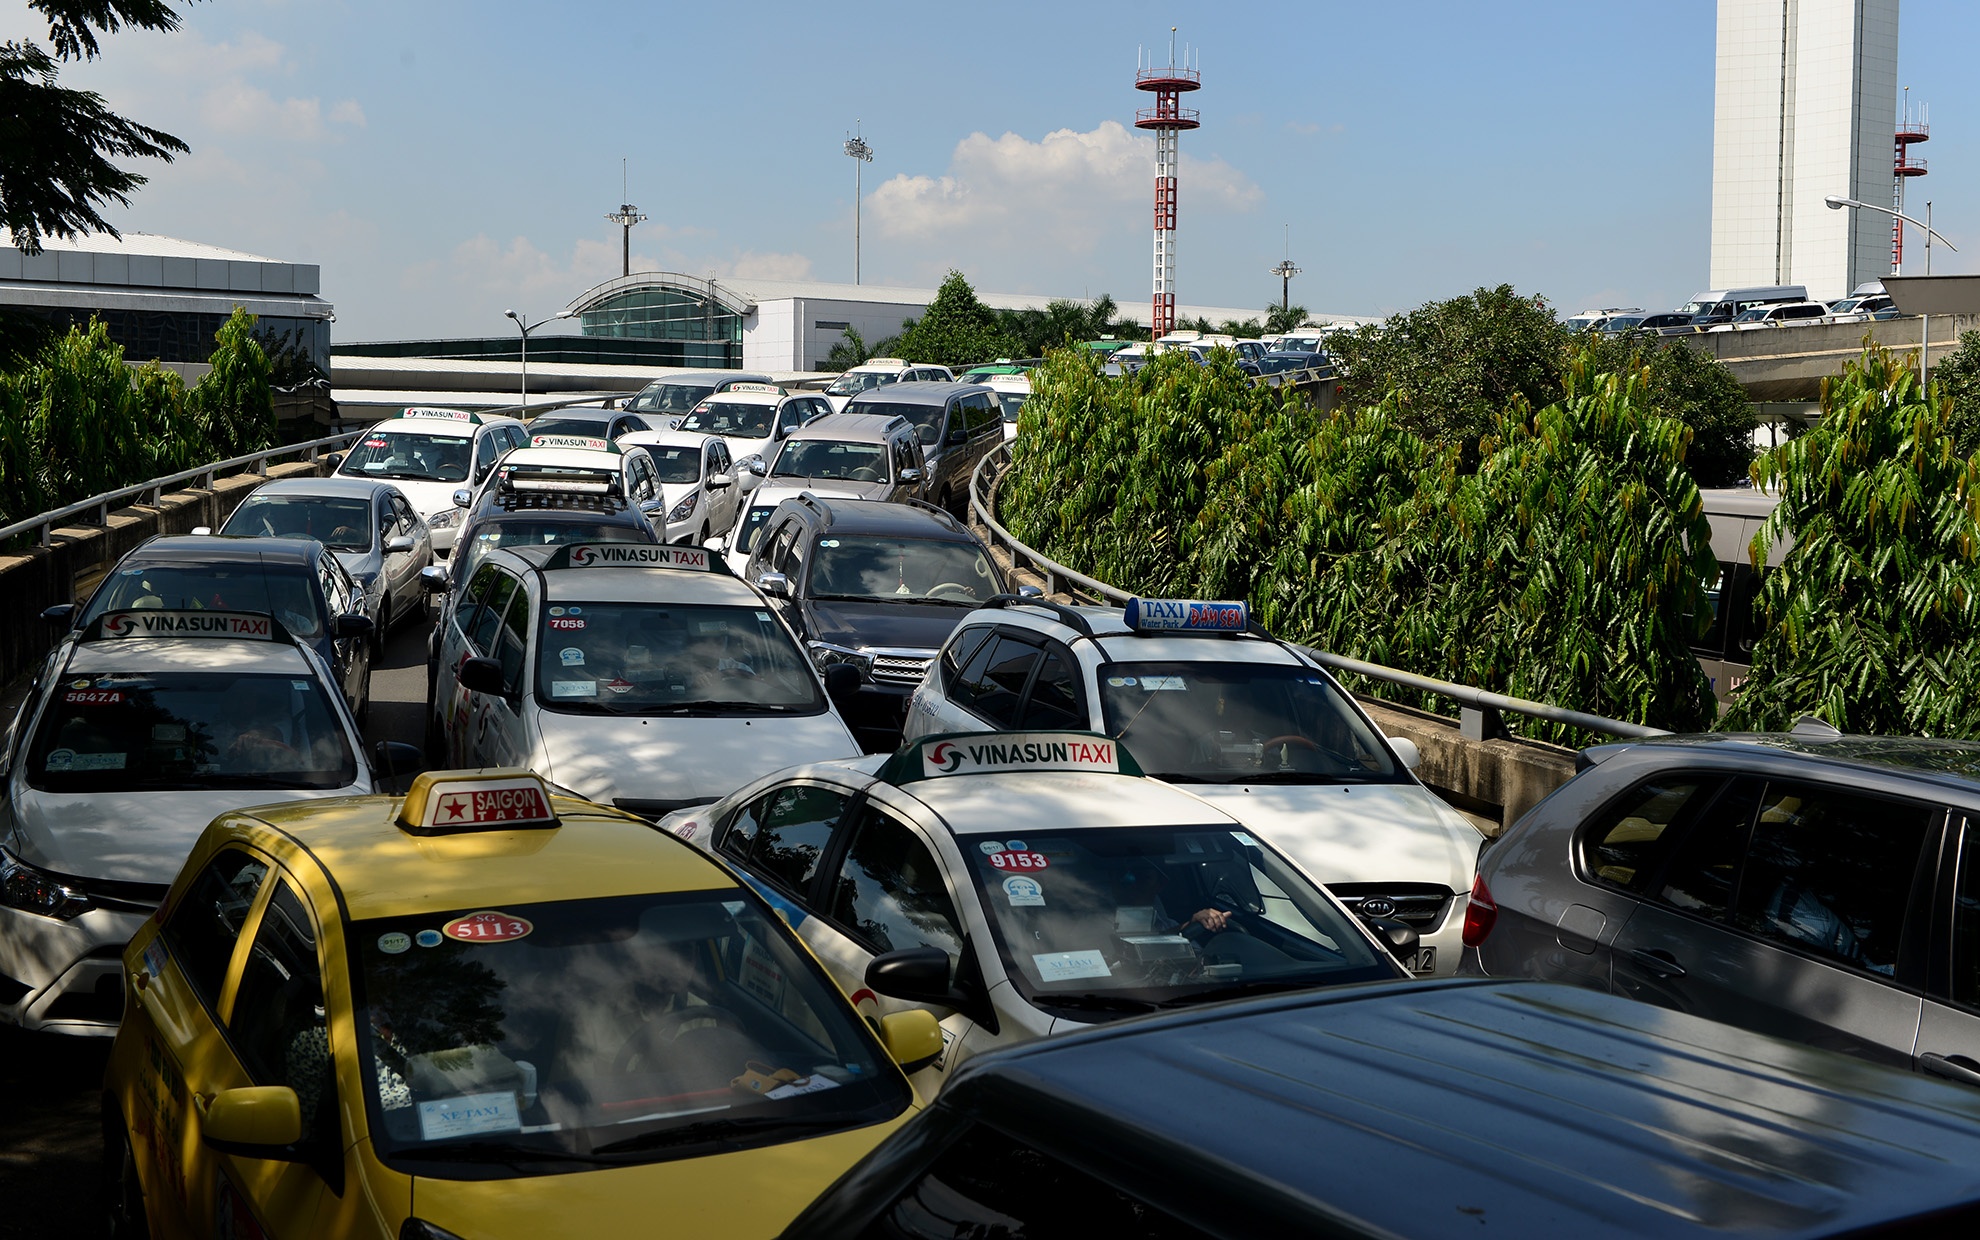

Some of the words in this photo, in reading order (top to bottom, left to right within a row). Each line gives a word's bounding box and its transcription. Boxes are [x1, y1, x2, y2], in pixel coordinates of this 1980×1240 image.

[1142, 601, 1185, 618] TAXI
[1219, 609, 1242, 627] SEN
[551, 619, 585, 629] 7058
[1141, 619, 1162, 628] Water
[1162, 619, 1180, 628] Park
[476, 789, 536, 811] SAIGON
[477, 807, 537, 821] TAXI
[990, 853, 1048, 868] 9153
[476, 914, 495, 923] SG
[457, 921, 524, 938] 5113
[440, 1111, 461, 1122] XE
[466, 1106, 500, 1119] TAXI
